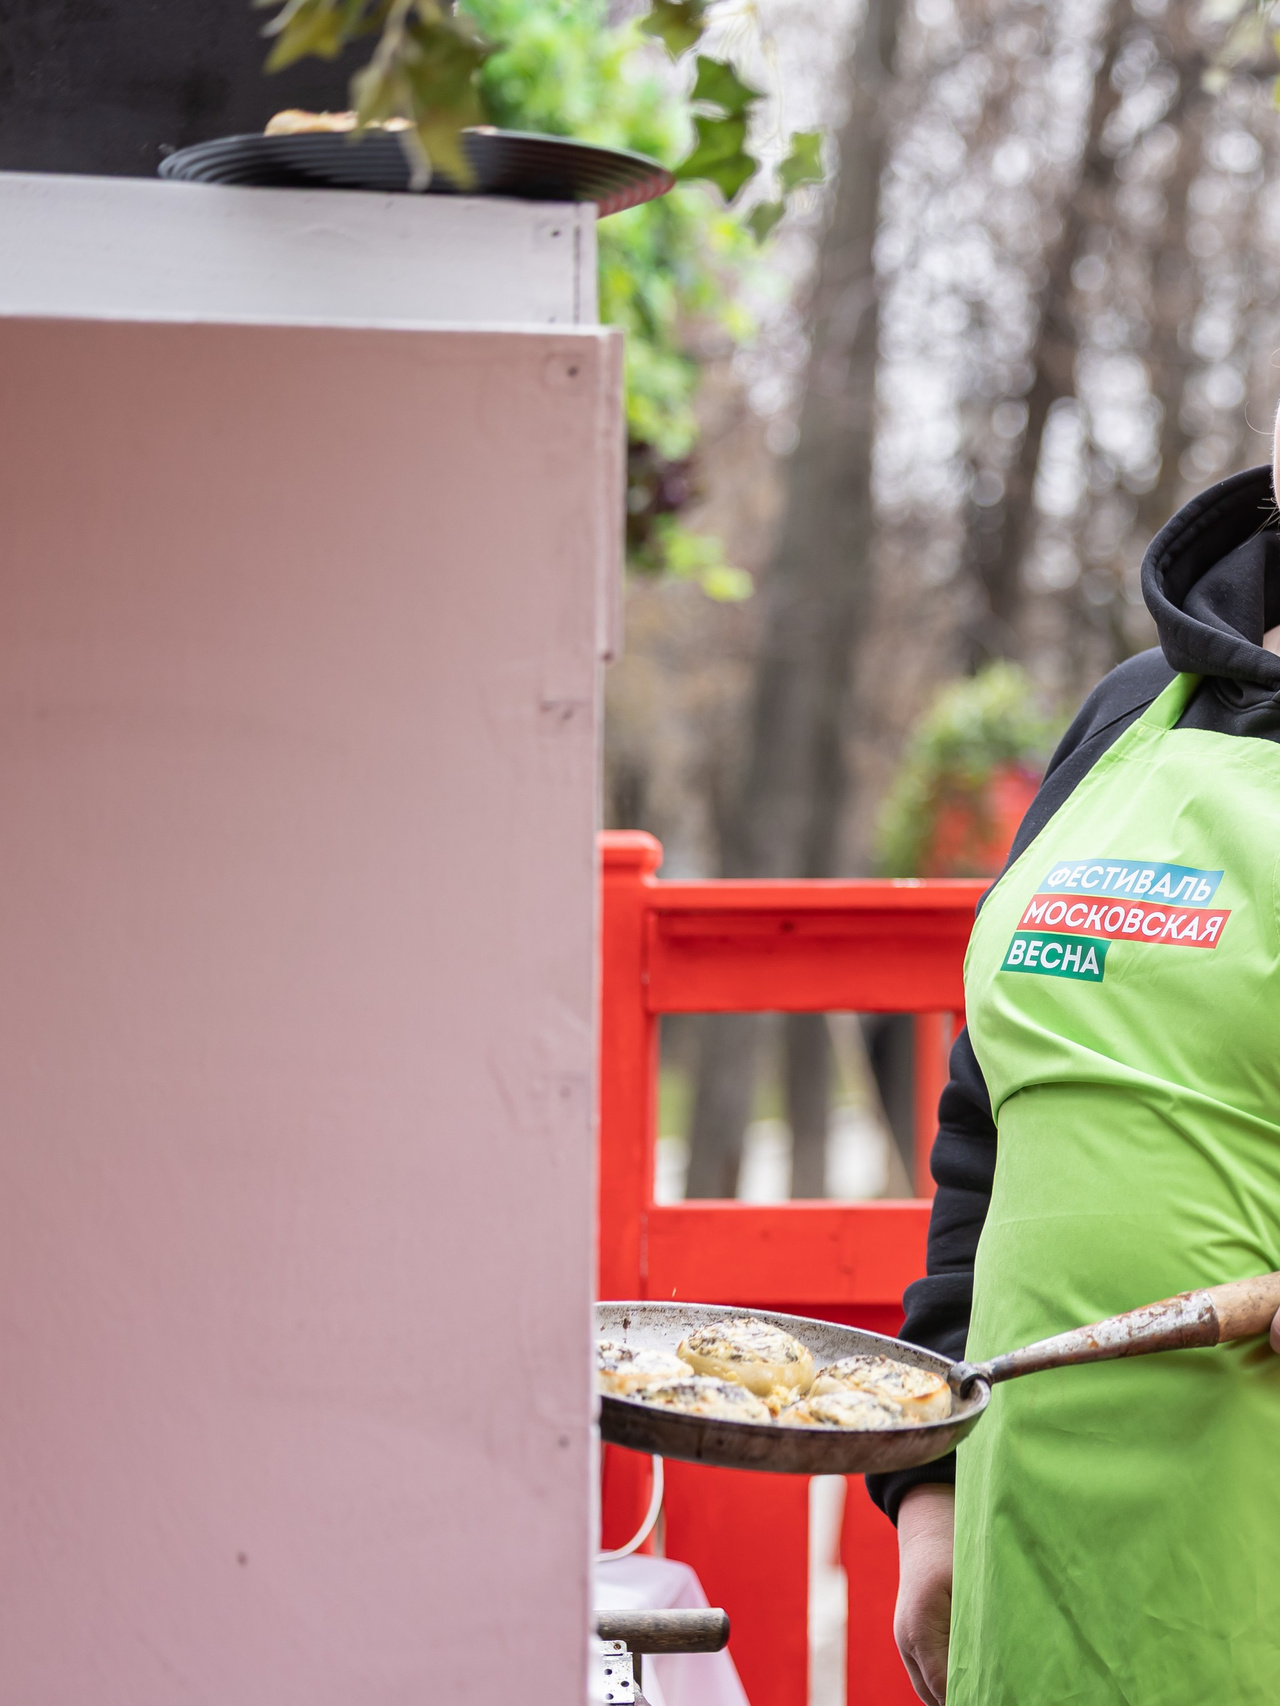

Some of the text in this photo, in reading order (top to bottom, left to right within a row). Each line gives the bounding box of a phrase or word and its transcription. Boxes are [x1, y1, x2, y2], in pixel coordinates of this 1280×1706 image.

[1047, 865, 1211, 901] ФЕСТИВАЛЬ
[1022, 900, 1223, 942] МОСКОВСКАЯ
[1006, 939, 1099, 974] ВЕСНА
